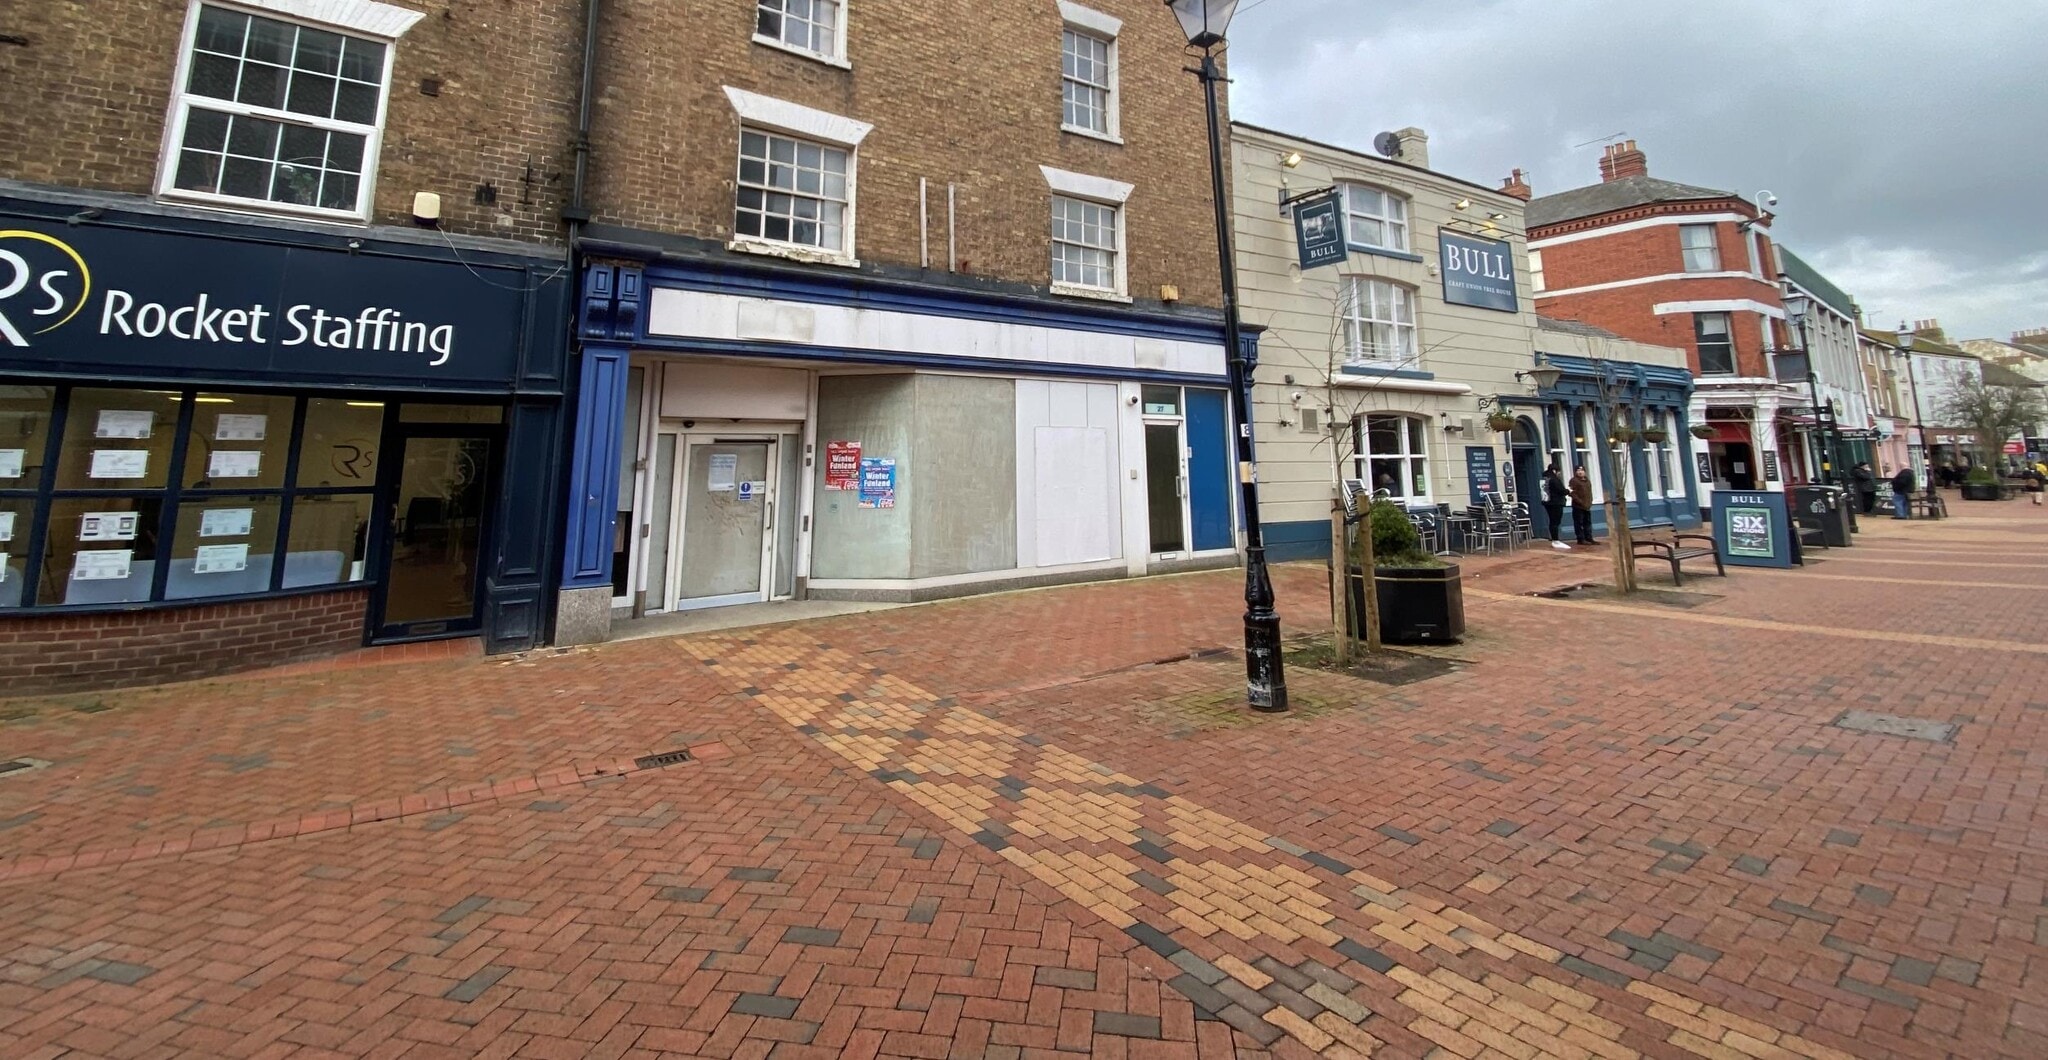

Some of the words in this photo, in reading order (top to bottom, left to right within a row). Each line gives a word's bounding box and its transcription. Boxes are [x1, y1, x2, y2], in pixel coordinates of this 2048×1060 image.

[1310, 245, 1336, 258] BULL
[1446, 244, 1510, 281] BULL
[100, 290, 270, 343] Rocket
[282, 304, 453, 366] Staffing
[831, 454, 856, 462] Winter
[865, 472, 890, 480] Winter
[1731, 495, 1764, 504] BULL
[1732, 516, 1764, 529] SIX
